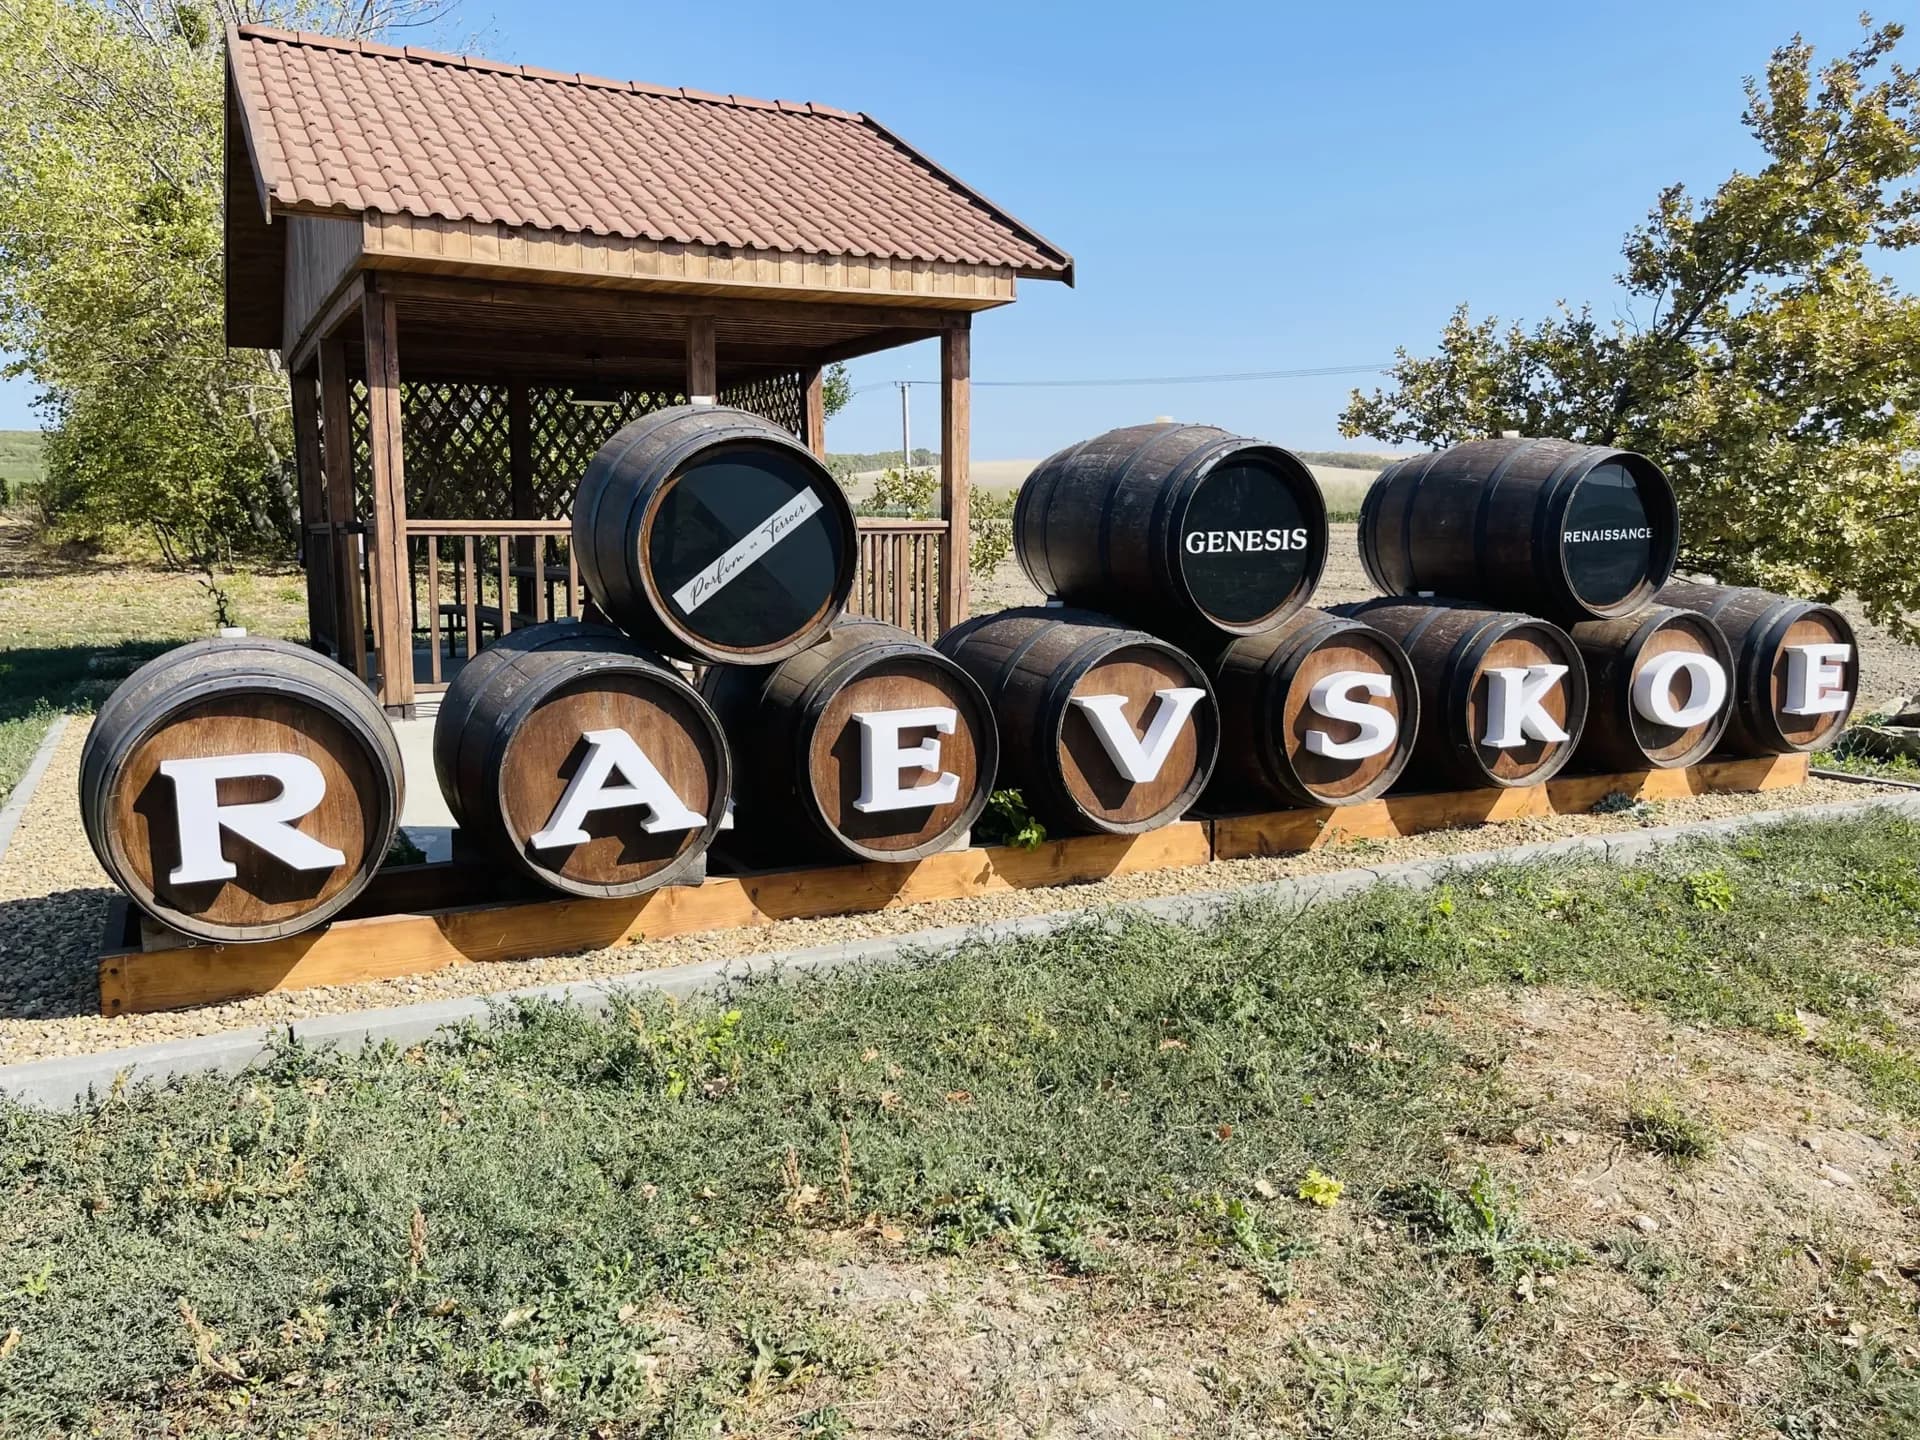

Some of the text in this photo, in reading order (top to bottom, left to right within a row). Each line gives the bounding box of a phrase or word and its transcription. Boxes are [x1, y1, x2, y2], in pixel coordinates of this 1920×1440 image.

[1185, 528, 1308, 554] GENESIS
[1563, 527, 1653, 543] RENAISSANCE
[690, 557, 745, 606] Parfum
